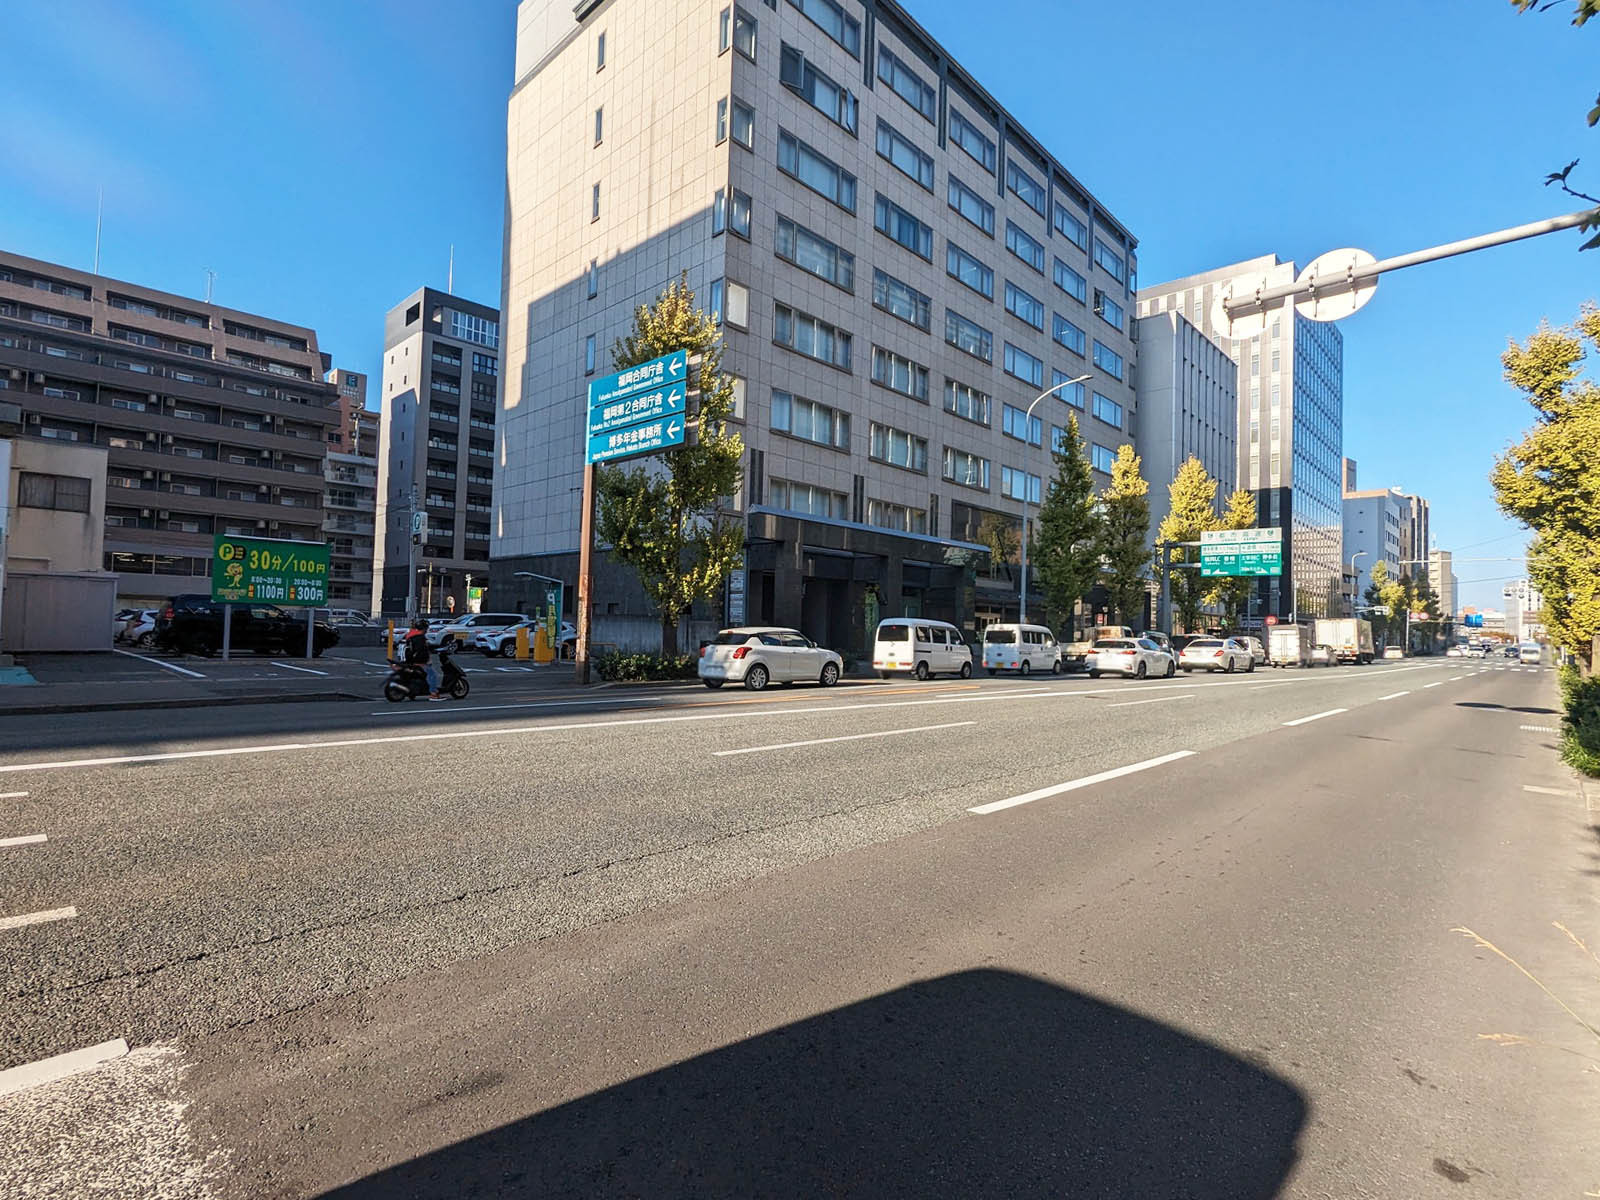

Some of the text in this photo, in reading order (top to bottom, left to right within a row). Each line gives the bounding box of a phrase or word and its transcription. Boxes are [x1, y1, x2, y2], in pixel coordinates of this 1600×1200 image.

[618, 362, 663, 387] 福岡合同庁舎
[609, 424, 661, 448] 博多年金事務所
[257, 585, 284, 599] 1100円
[297, 586, 323, 600] 300円
